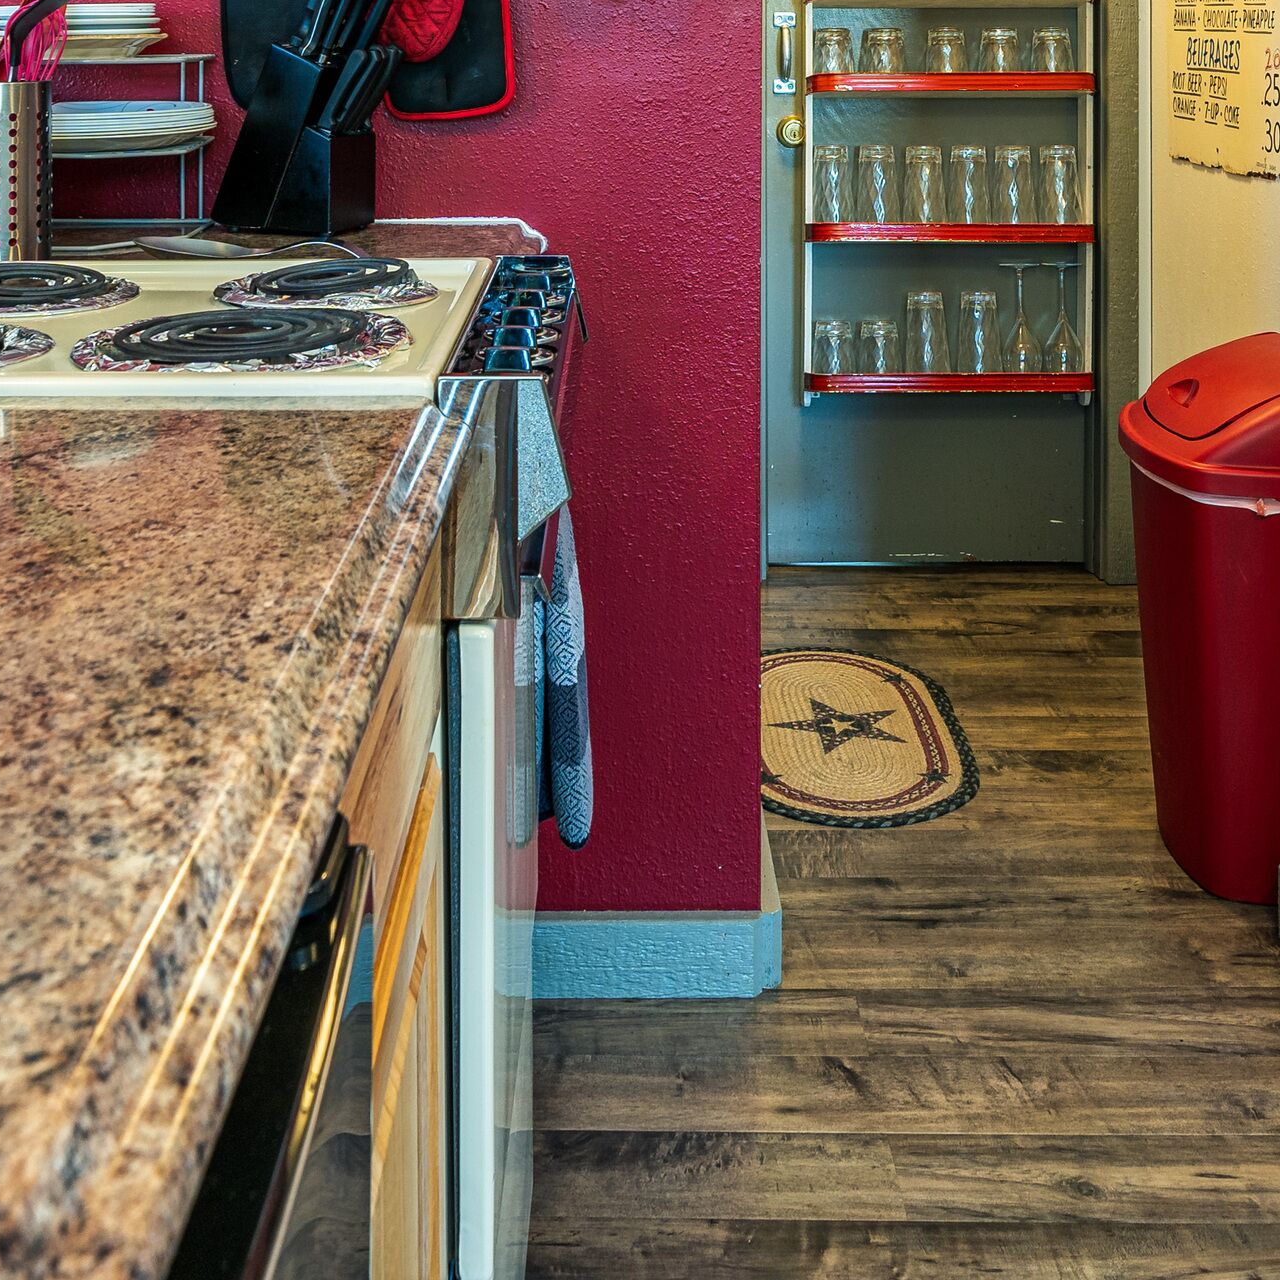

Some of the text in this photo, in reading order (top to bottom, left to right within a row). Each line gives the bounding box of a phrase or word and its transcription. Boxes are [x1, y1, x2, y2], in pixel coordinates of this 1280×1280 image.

[1173, 9, 1275, 30] BANANA CHOCOLATE PINEAPPLE
[1186, 37, 1241, 71] BEVERAGES
[1172, 71, 1185, 90] ROOT
[1187, 73, 1202, 93] BEER
[1208, 75, 1227, 96] PEPSI
[1172, 97, 1240, 124] ORANGE 7-UP COKE
